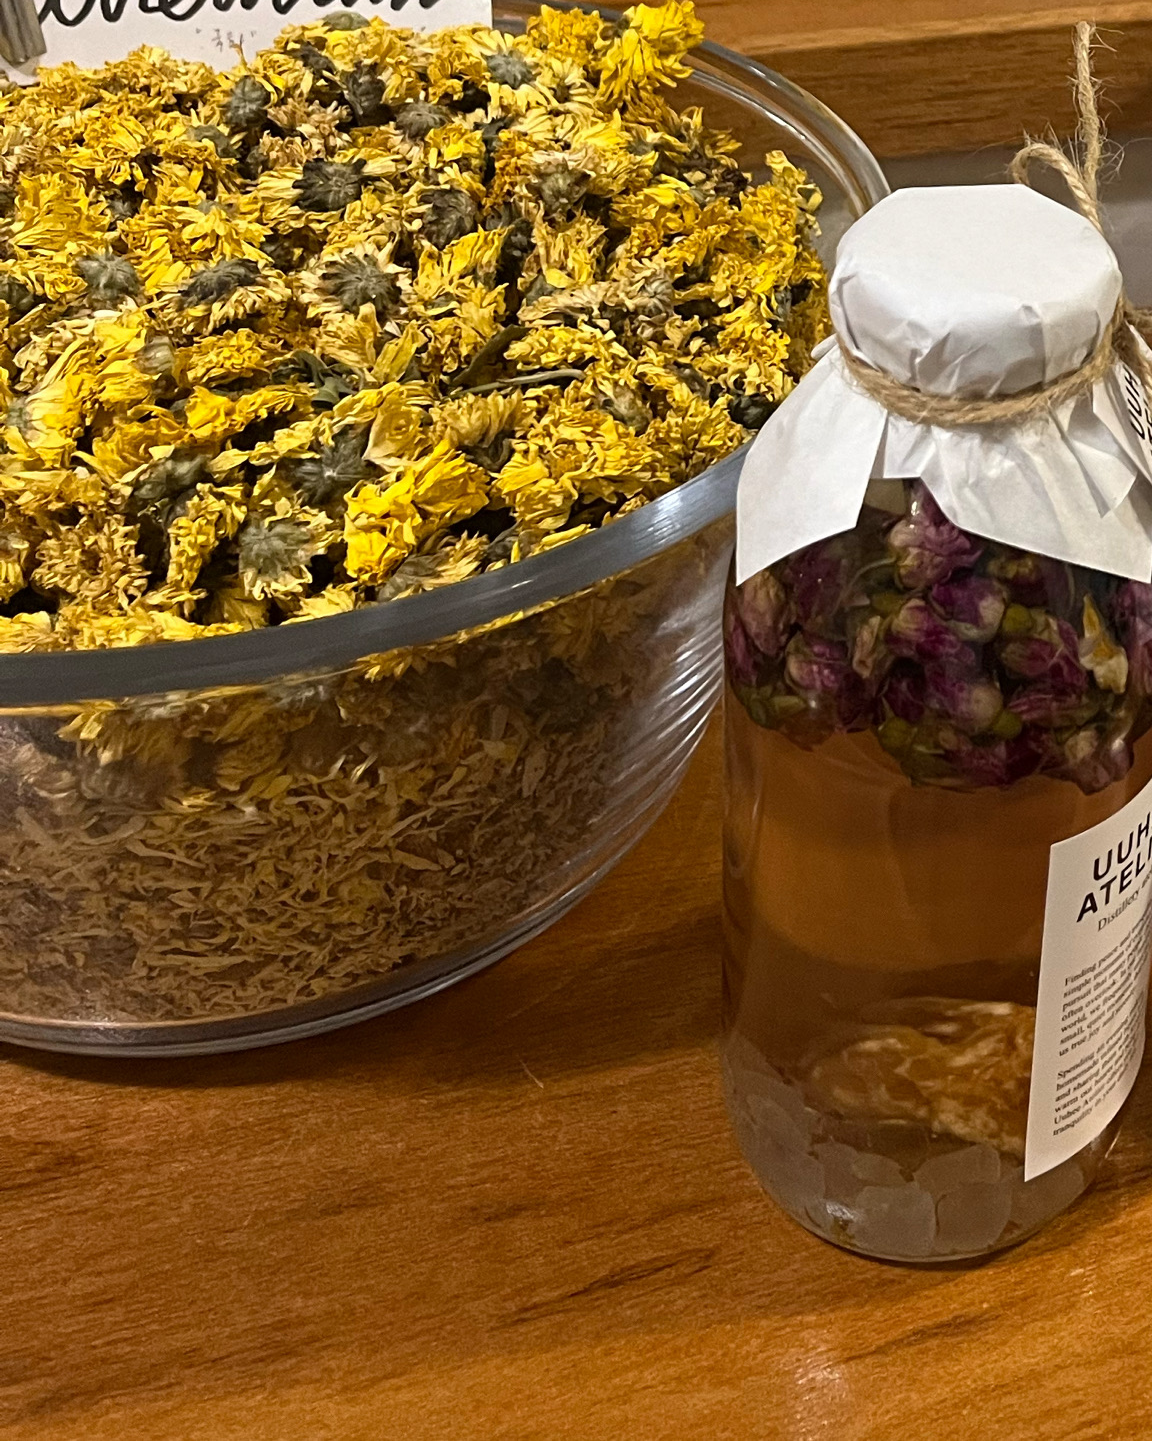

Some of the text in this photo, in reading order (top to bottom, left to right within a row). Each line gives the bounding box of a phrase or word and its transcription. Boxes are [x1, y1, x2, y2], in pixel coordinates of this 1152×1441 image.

[1097, 884, 1140, 932] Distillery
[1065, 963, 1097, 986] Finding
[1059, 1046, 1069, 1056] us
[1055, 1089, 1071, 1102] and
[1055, 1095, 1079, 1113] warm
